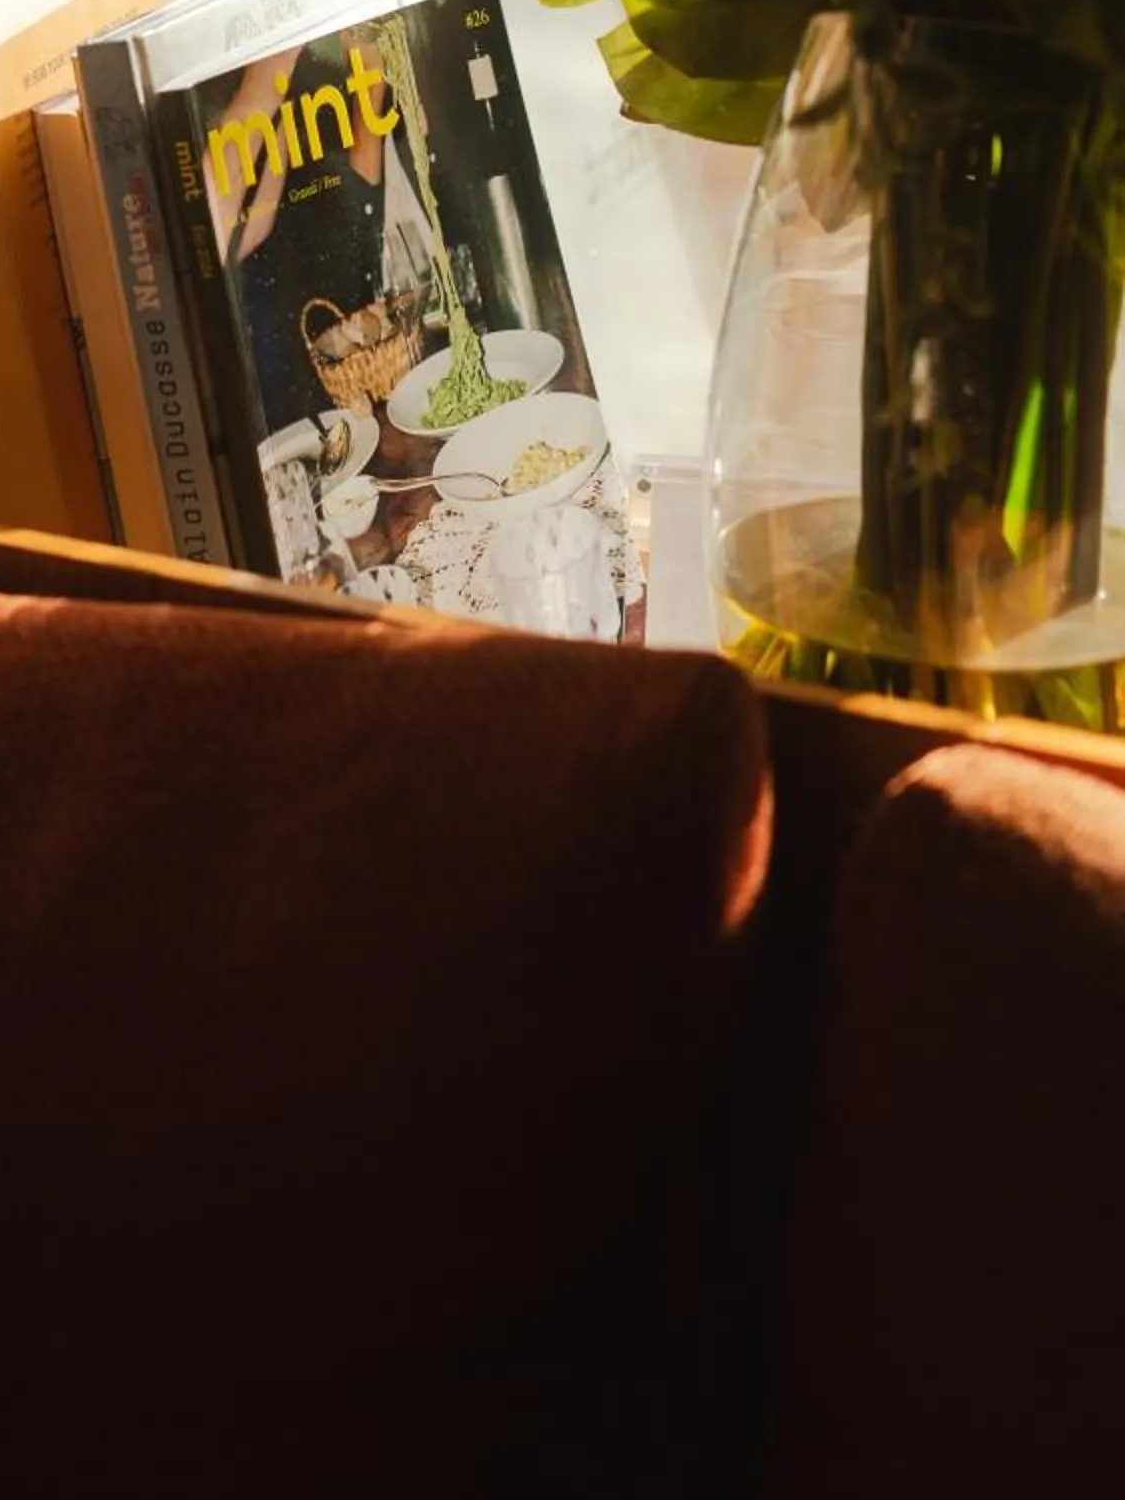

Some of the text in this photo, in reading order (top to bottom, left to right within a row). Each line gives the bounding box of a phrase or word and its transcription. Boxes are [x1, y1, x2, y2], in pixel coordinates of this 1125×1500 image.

[466, 8, 490, 29] #26
[175, 141, 203, 202] mint
[208, 47, 401, 199] mint
[122, 194, 163, 312] Nature
[145, 318, 190, 458] Ducasse
